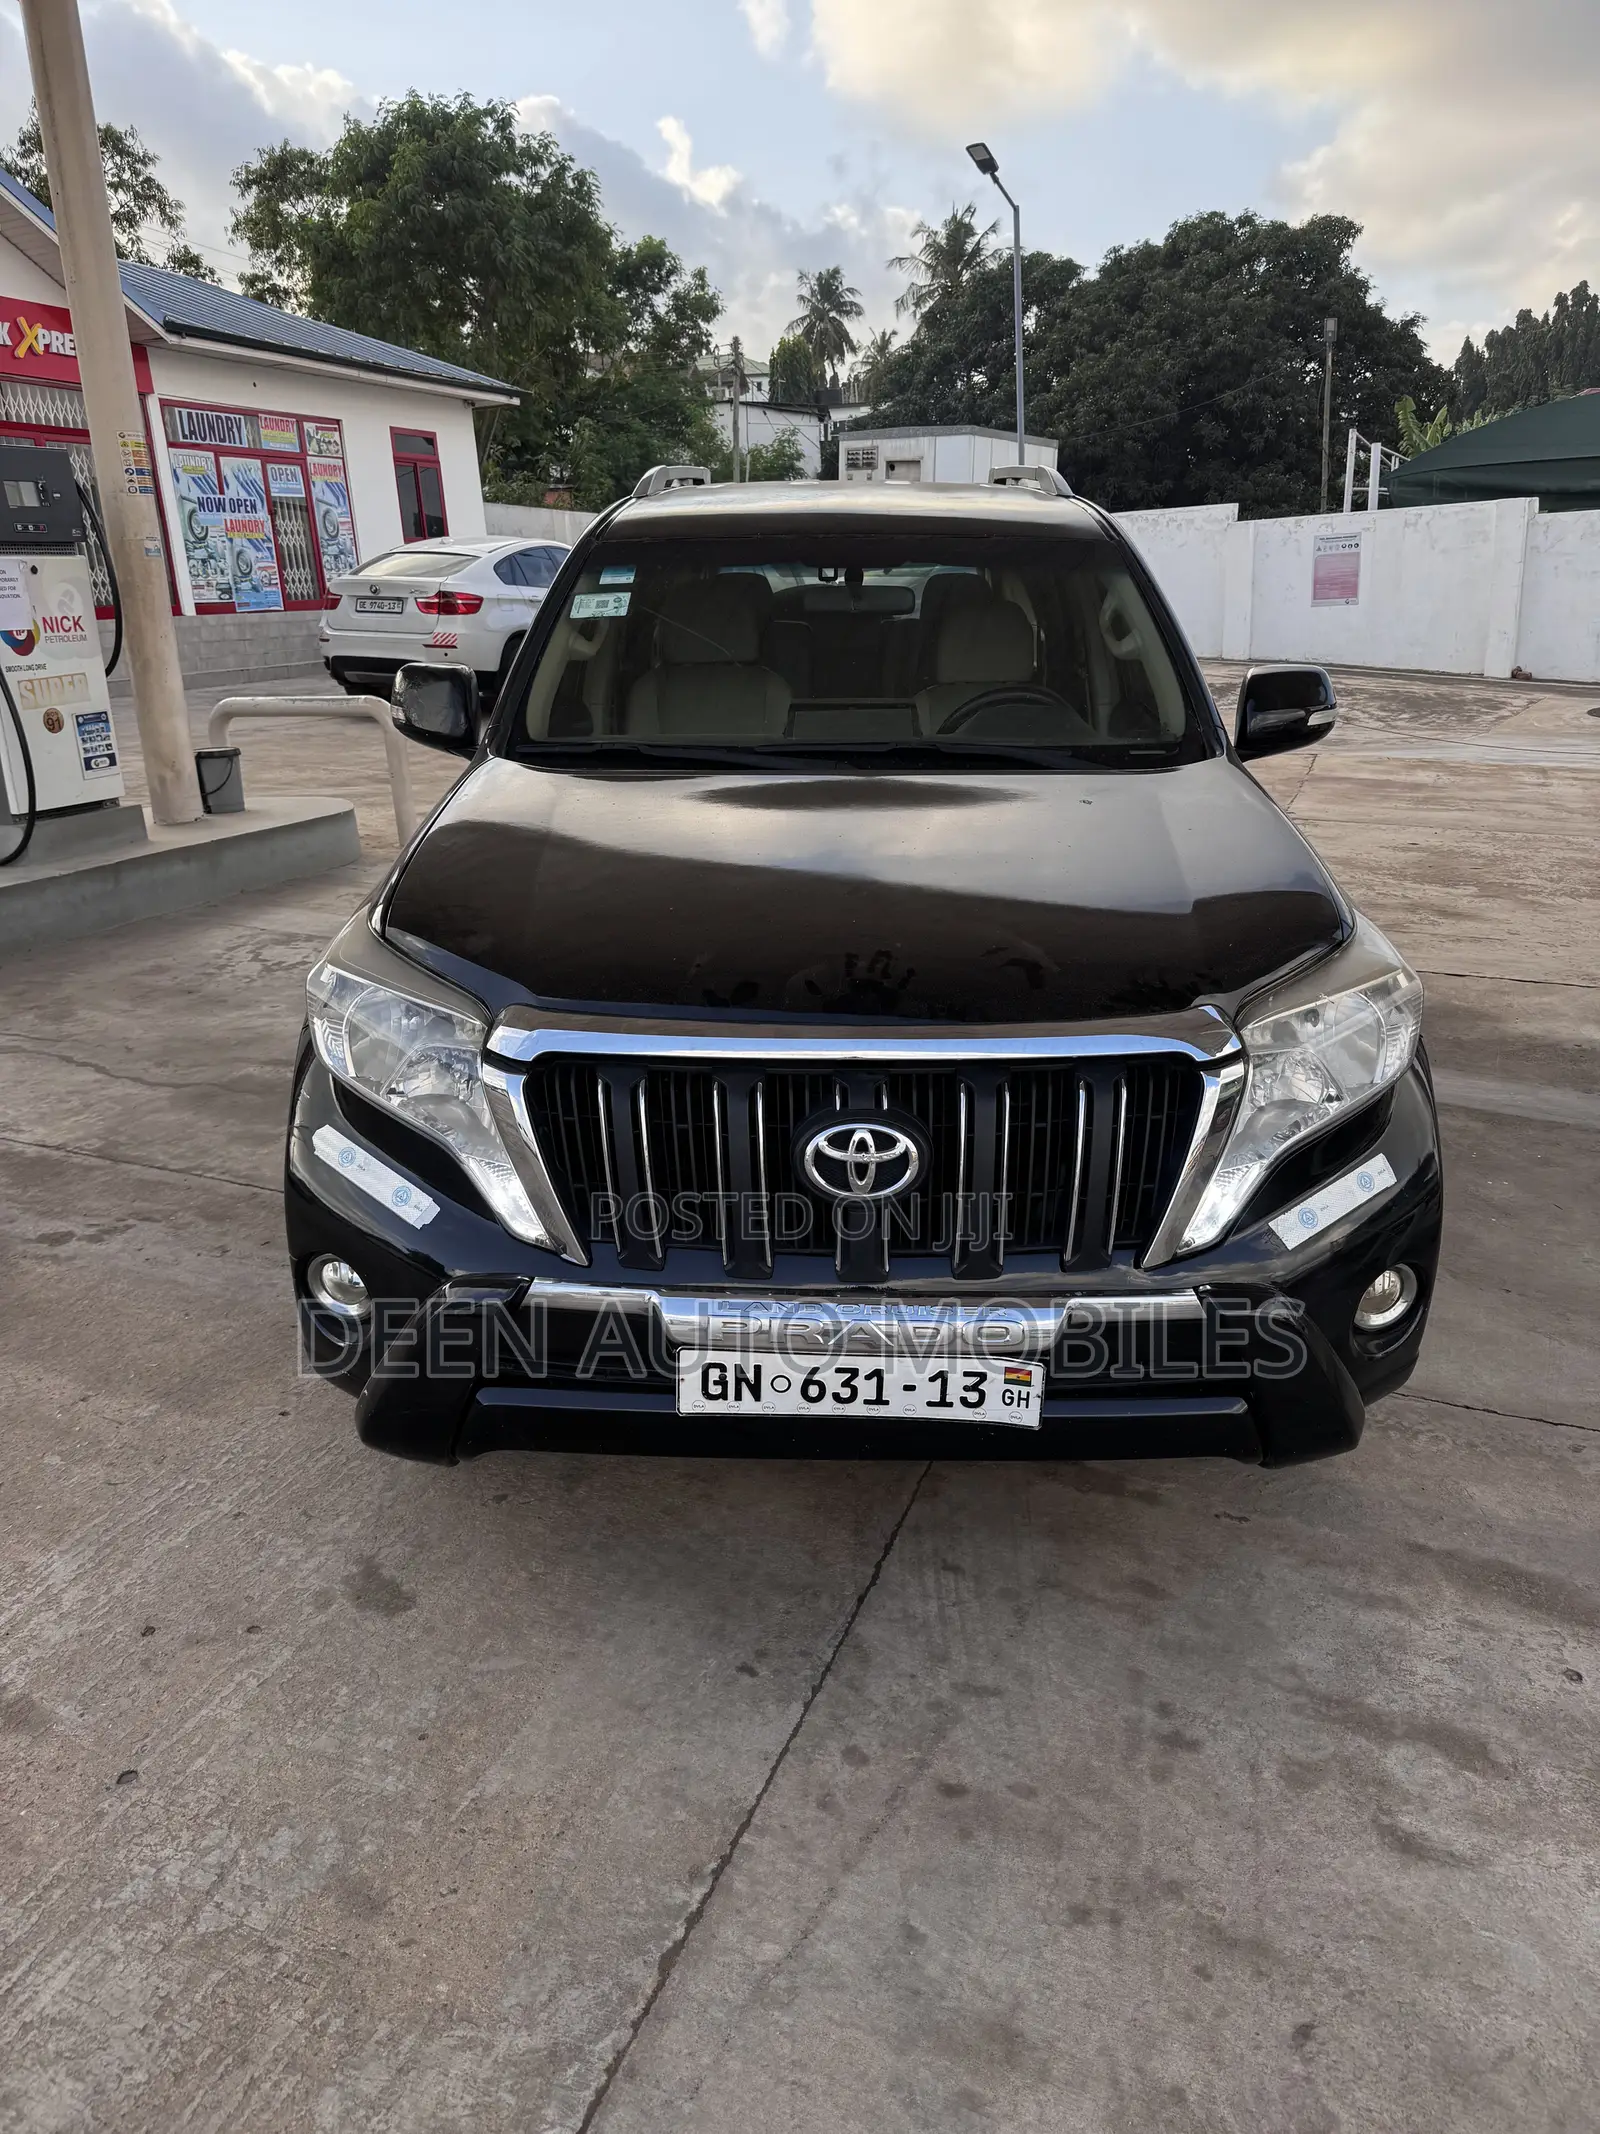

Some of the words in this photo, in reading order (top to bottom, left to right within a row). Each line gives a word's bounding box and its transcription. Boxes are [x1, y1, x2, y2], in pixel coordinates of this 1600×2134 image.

[178, 410, 243, 445] LAUNDRY
[260, 416, 296, 433] LAUNDRY
[270, 466, 298, 482] OPEN
[309, 462, 342, 478] LAUNDRY
[197, 496, 226, 513] NOW
[229, 498, 258, 514] OPEN
[224, 518, 265, 533] LAUNDRY
[42, 615, 85, 634] NICK
[45, 634, 88, 644] PETROLEUM
[5, 664, 23, 673] SMOOTH
[23, 664, 35, 672] LONG
[35, 663, 47, 671] DRIVE
[19, 674, 90, 707] SUPER
[47, 716, 62, 731] 91
[720, 1300, 830, 1316] LAND
[838, 1303, 1009, 1318] CRUISER
[707, 1315, 1027, 1348] PRADO
[701, 1361, 763, 1403] GN
[1001, 1388, 1031, 1410] GH
